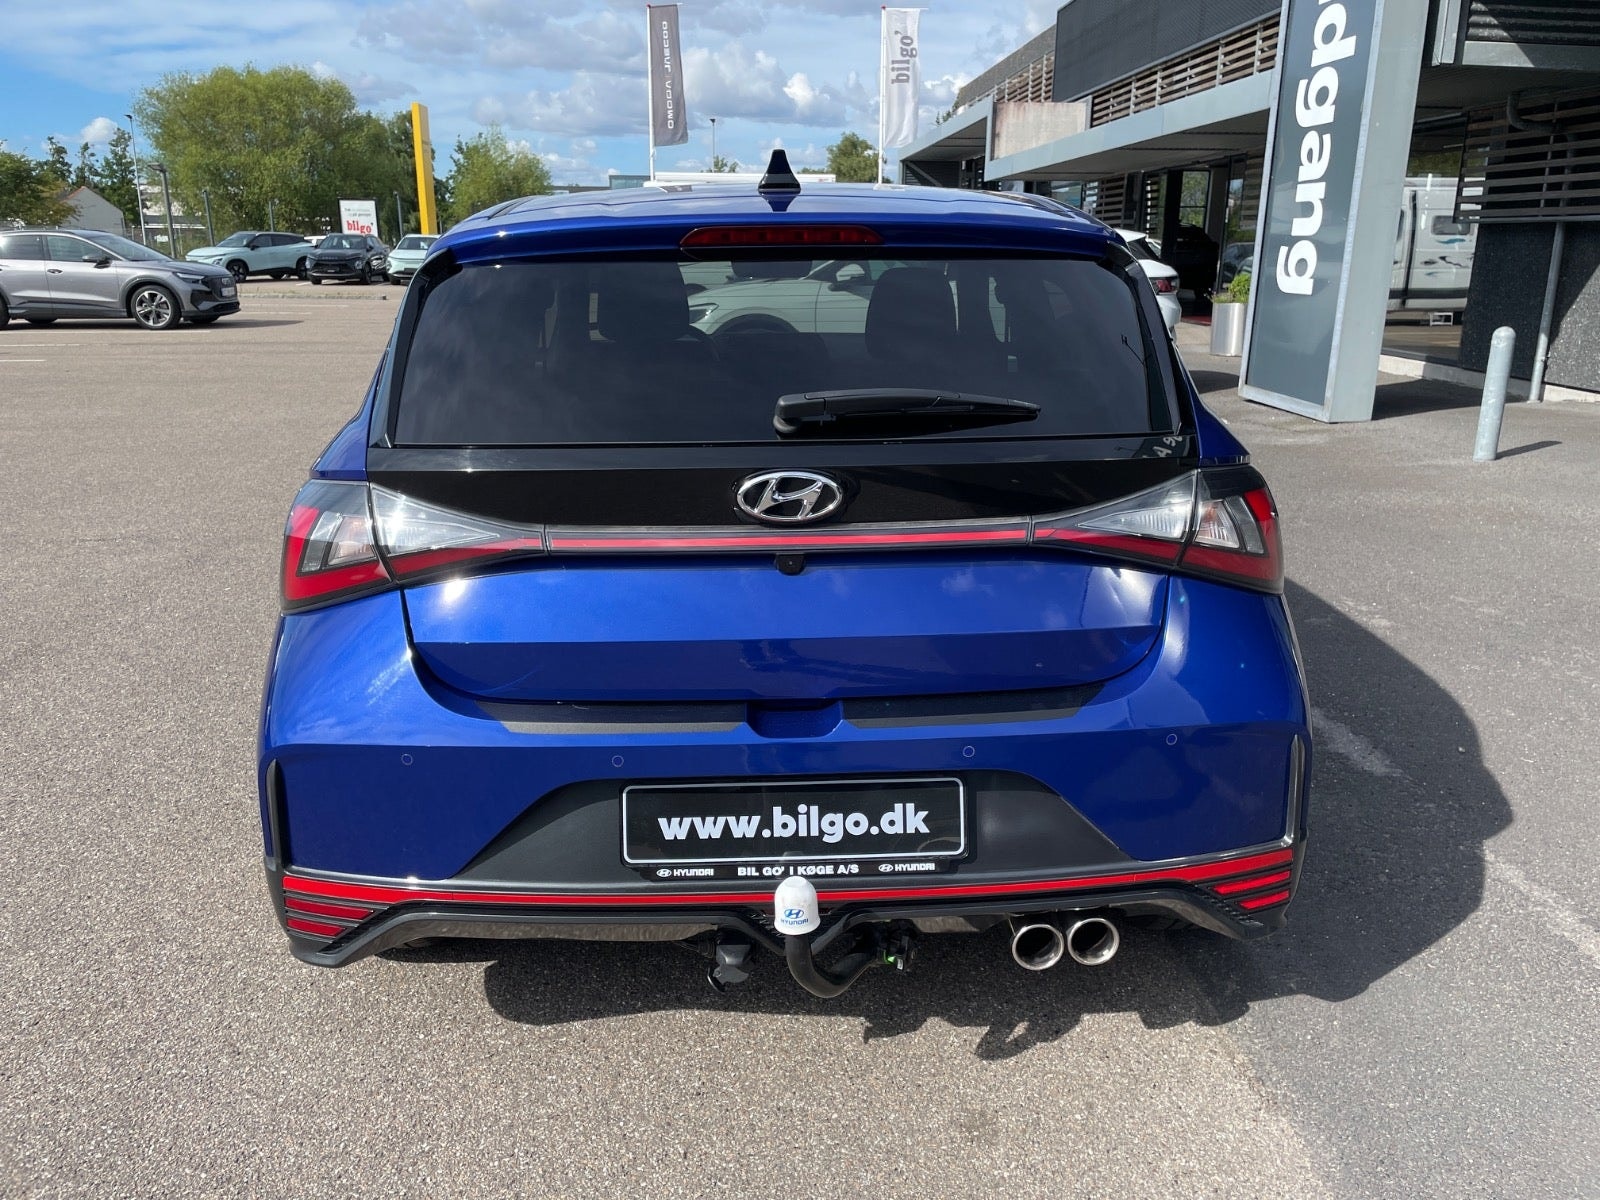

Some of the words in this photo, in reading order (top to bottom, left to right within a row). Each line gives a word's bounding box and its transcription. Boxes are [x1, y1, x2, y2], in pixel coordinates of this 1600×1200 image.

[662, 21, 672, 73] JAECOO
[666, 80, 675, 129] OMODA
[1276, 0, 1357, 296] dgang
[657, 803, 931, 844] www.bilgo.dk
[673, 868, 714, 877] HYUNDAI
[737, 866, 760, 876] BIL
[797, 865, 834, 876] KØGE
[836, 864, 860, 875] A/S
[894, 863, 936, 872] HYUNDAI
[780, 918, 809, 926] HYUNDAI
